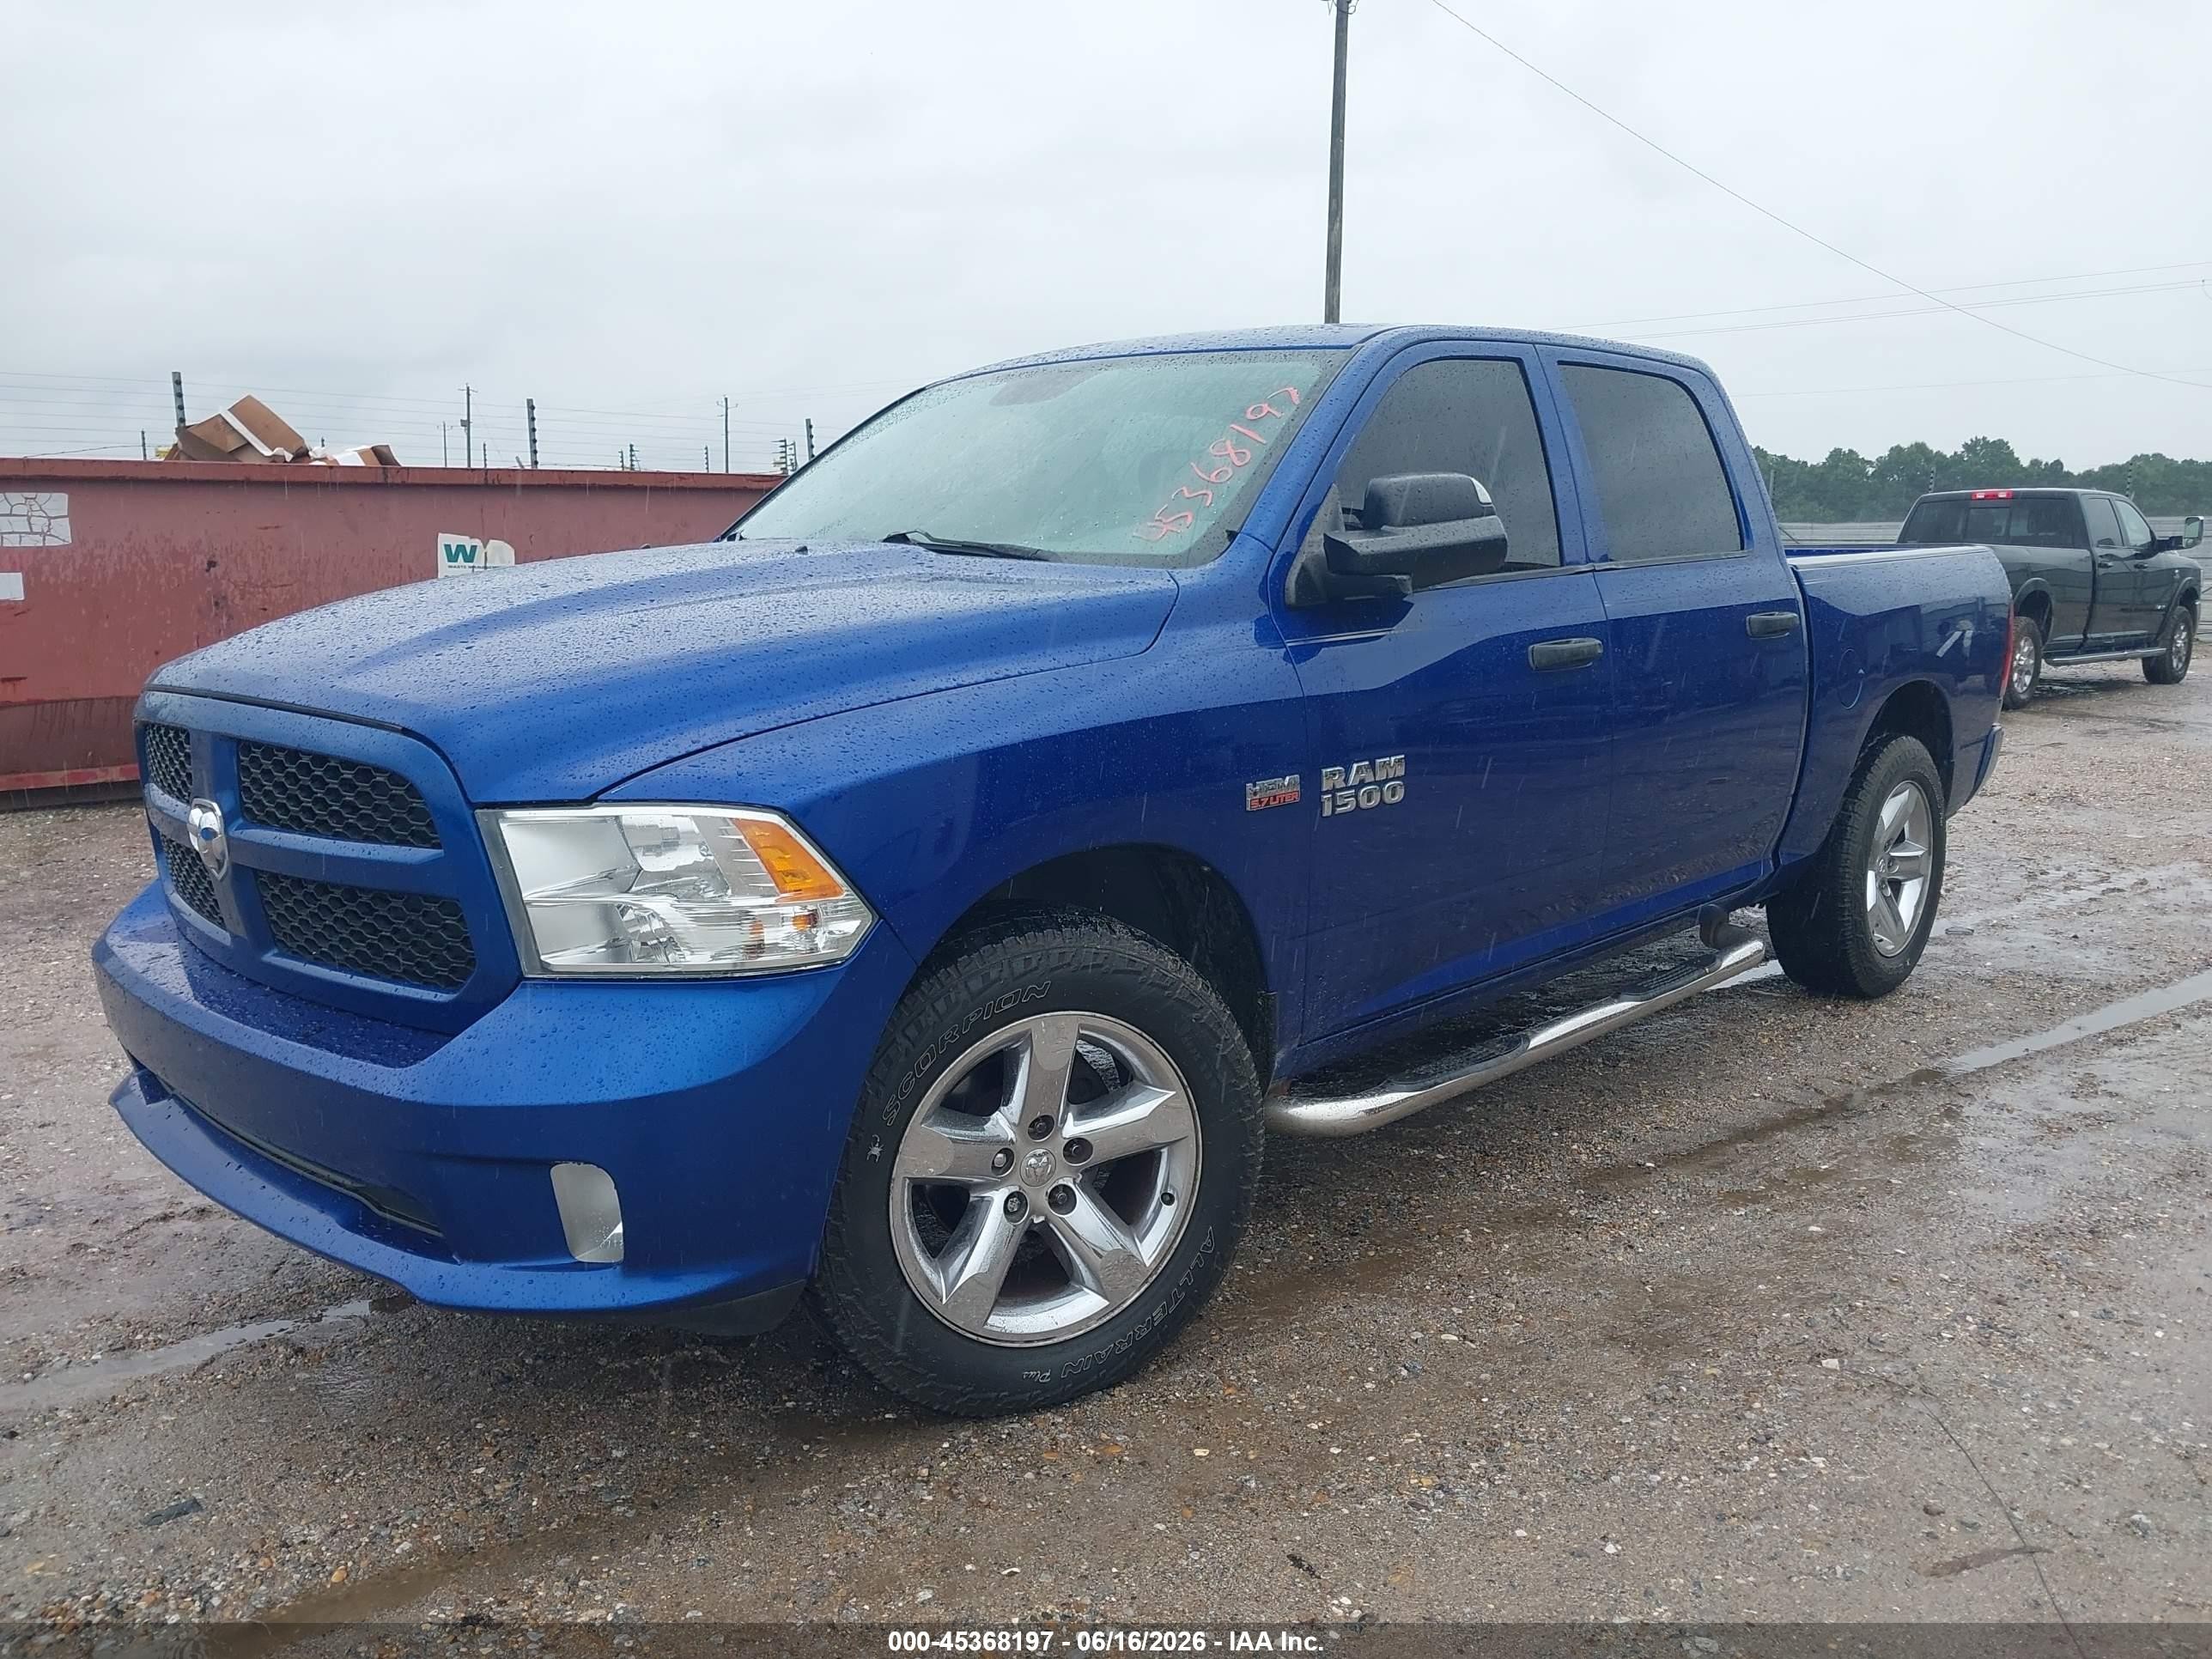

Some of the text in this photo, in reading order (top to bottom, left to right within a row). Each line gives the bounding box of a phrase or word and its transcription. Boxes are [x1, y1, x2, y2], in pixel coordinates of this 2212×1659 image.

[1321, 754, 1406, 792] RAM
[1269, 791, 1299, 805] LITER
[1321, 780, 1406, 817] 1500
[882, 981, 1051, 1127] SCORPION
[1179, 1225, 1215, 1286] ALL
[1060, 1287, 1186, 1379] TERRAIN
